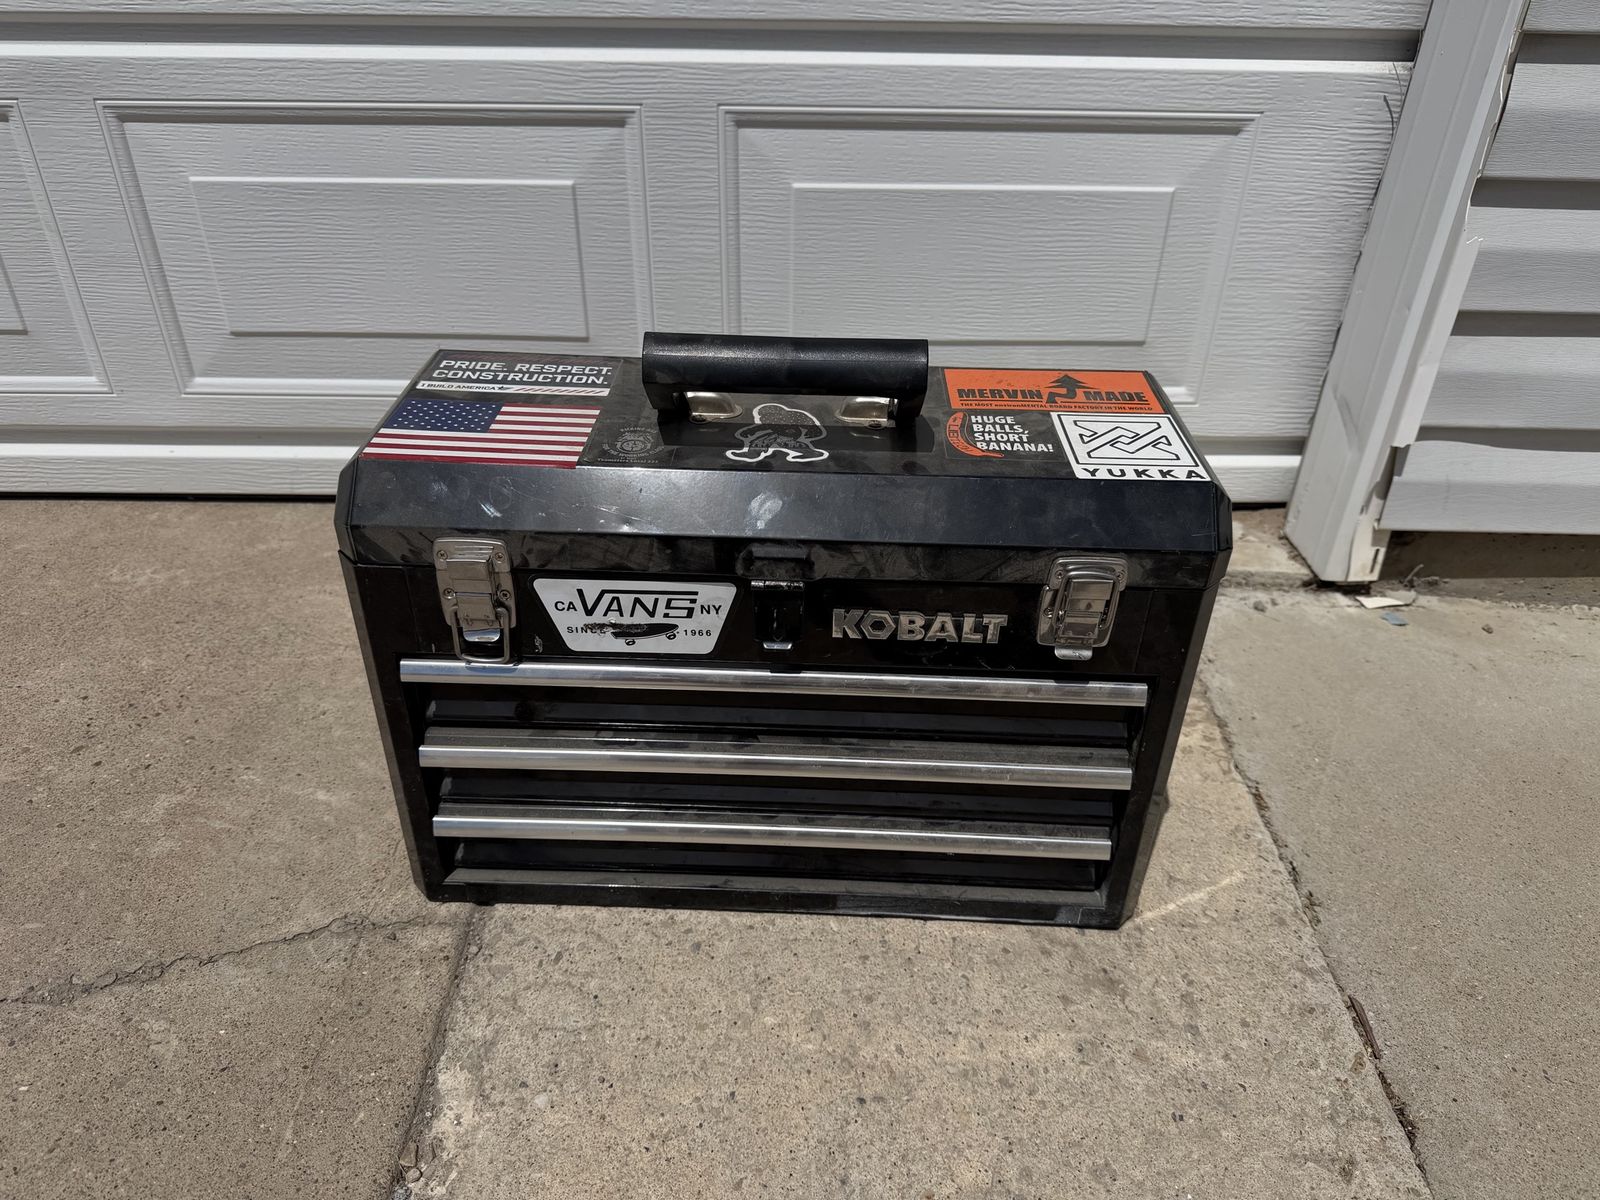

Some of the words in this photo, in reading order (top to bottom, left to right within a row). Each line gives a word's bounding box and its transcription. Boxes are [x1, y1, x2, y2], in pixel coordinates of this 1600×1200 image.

[439, 360, 507, 371] PRIDE.
[514, 363, 612, 375] RESPECT.
[432, 370, 608, 385] CONSTRUCTION.
[957, 388, 1043, 399] MERVIN
[1083, 390, 1148, 402] MADE
[971, 415, 1015, 425] HUGE
[973, 424, 1028, 435] BALLS,
[974, 433, 1028, 443] SHORT
[976, 441, 1053, 452] BANANA!
[1081, 467, 1207, 480] YUKKA
[554, 601, 577, 612] CA
[576, 588, 699, 619] VANS
[700, 604, 722, 615] NY
[832, 608, 1009, 644] KOBALT
[683, 629, 712, 637] 1966
